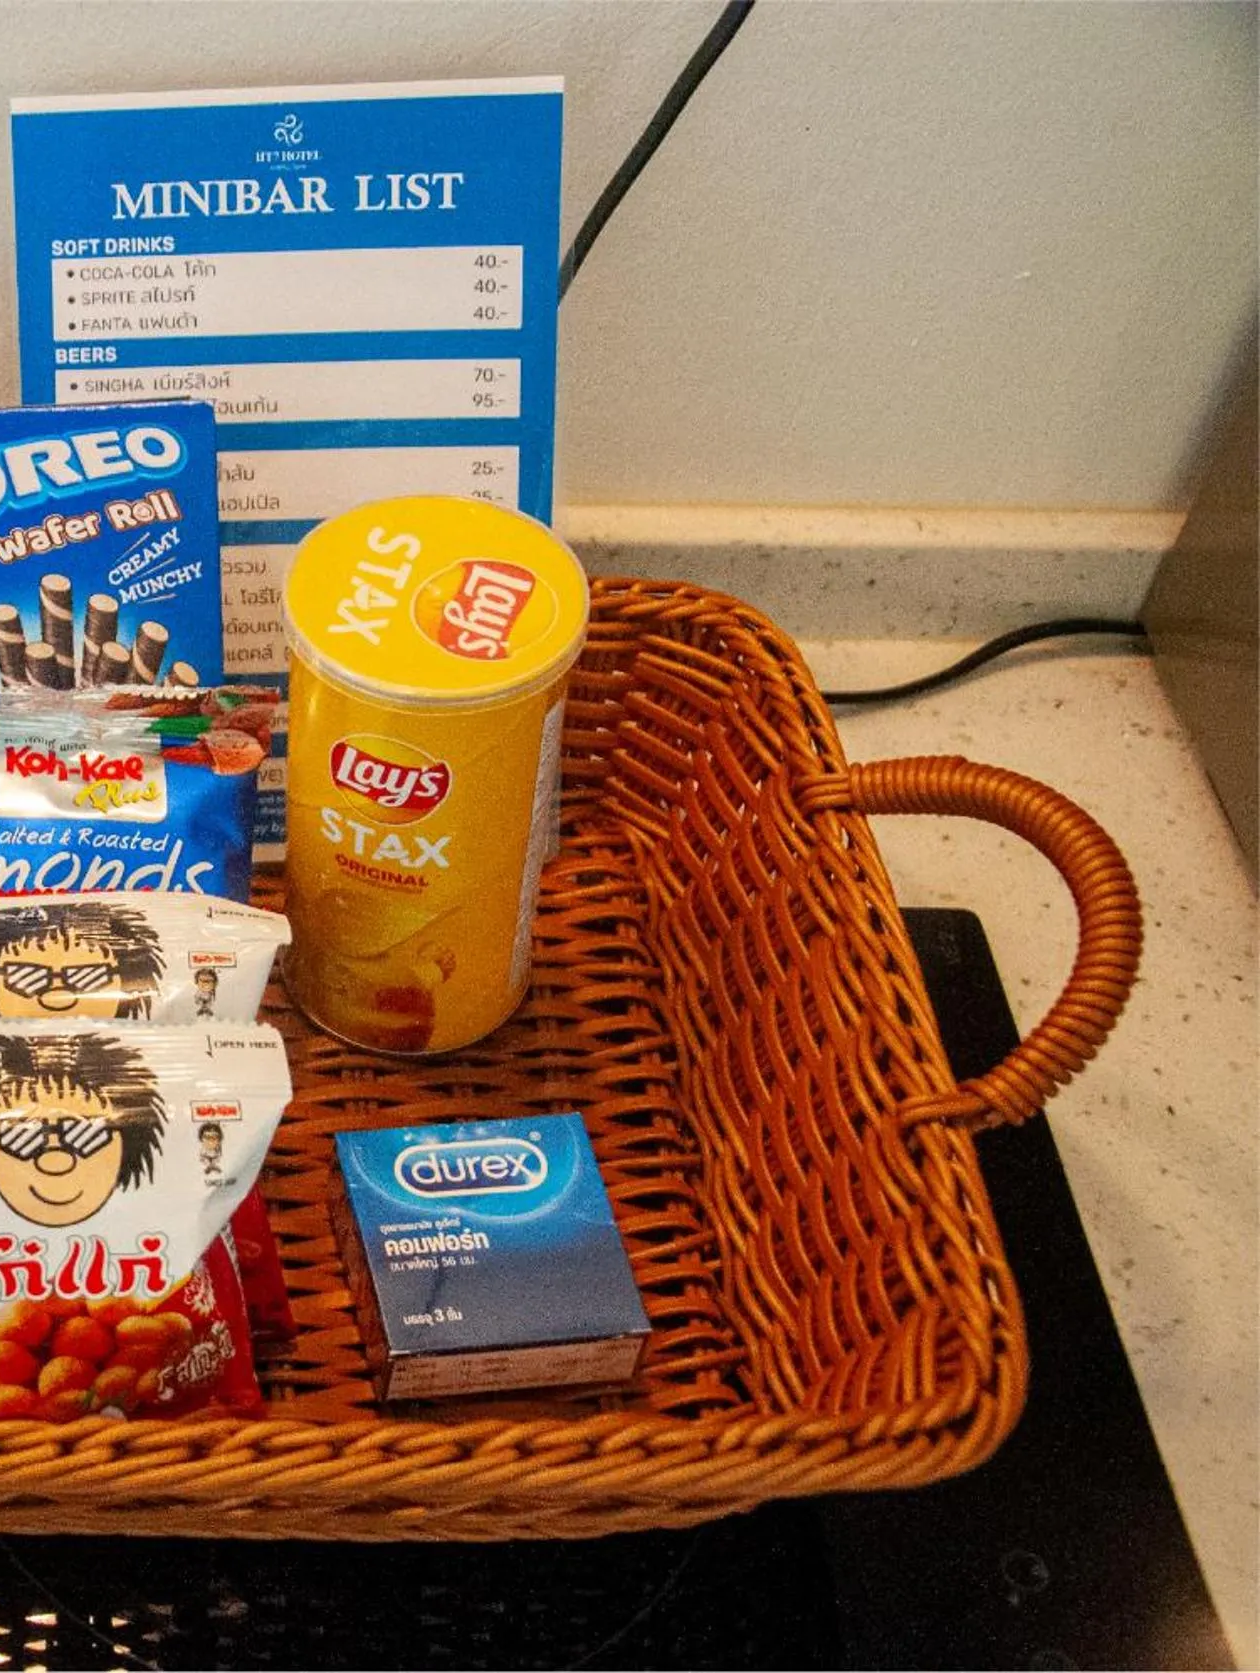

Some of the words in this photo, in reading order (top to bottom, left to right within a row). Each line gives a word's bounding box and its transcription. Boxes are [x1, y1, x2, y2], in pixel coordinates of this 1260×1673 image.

[112, 176, 334, 219] MINIBAR
[355, 172, 464, 211] LIST
[52, 239, 100, 256] SOFT
[105, 236, 175, 254] DRINKS
[80, 264, 175, 281] COCA-COLA
[82, 290, 136, 306] SPRITE
[82, 316, 132, 331] FANTA
[55, 346, 117, 364] BEERS
[84, 377, 144, 393] SINGHA
[106, 490, 181, 531] Roll
[109, 527, 181, 585] CREAMY
[119, 562, 203, 604] MUNCHY
[328, 526, 421, 646] STAX
[5, 746, 145, 782] Koh-Kae
[337, 746, 444, 808] Lay's
[73, 780, 161, 813] Plus
[59, 829, 71, 846] &
[78, 828, 170, 852] Roasted
[321, 806, 452, 868] STAX
[335, 853, 429, 887] ORIGINAL
[411, 1152, 535, 1185] durex
[434, 1309, 444, 1322] 3
